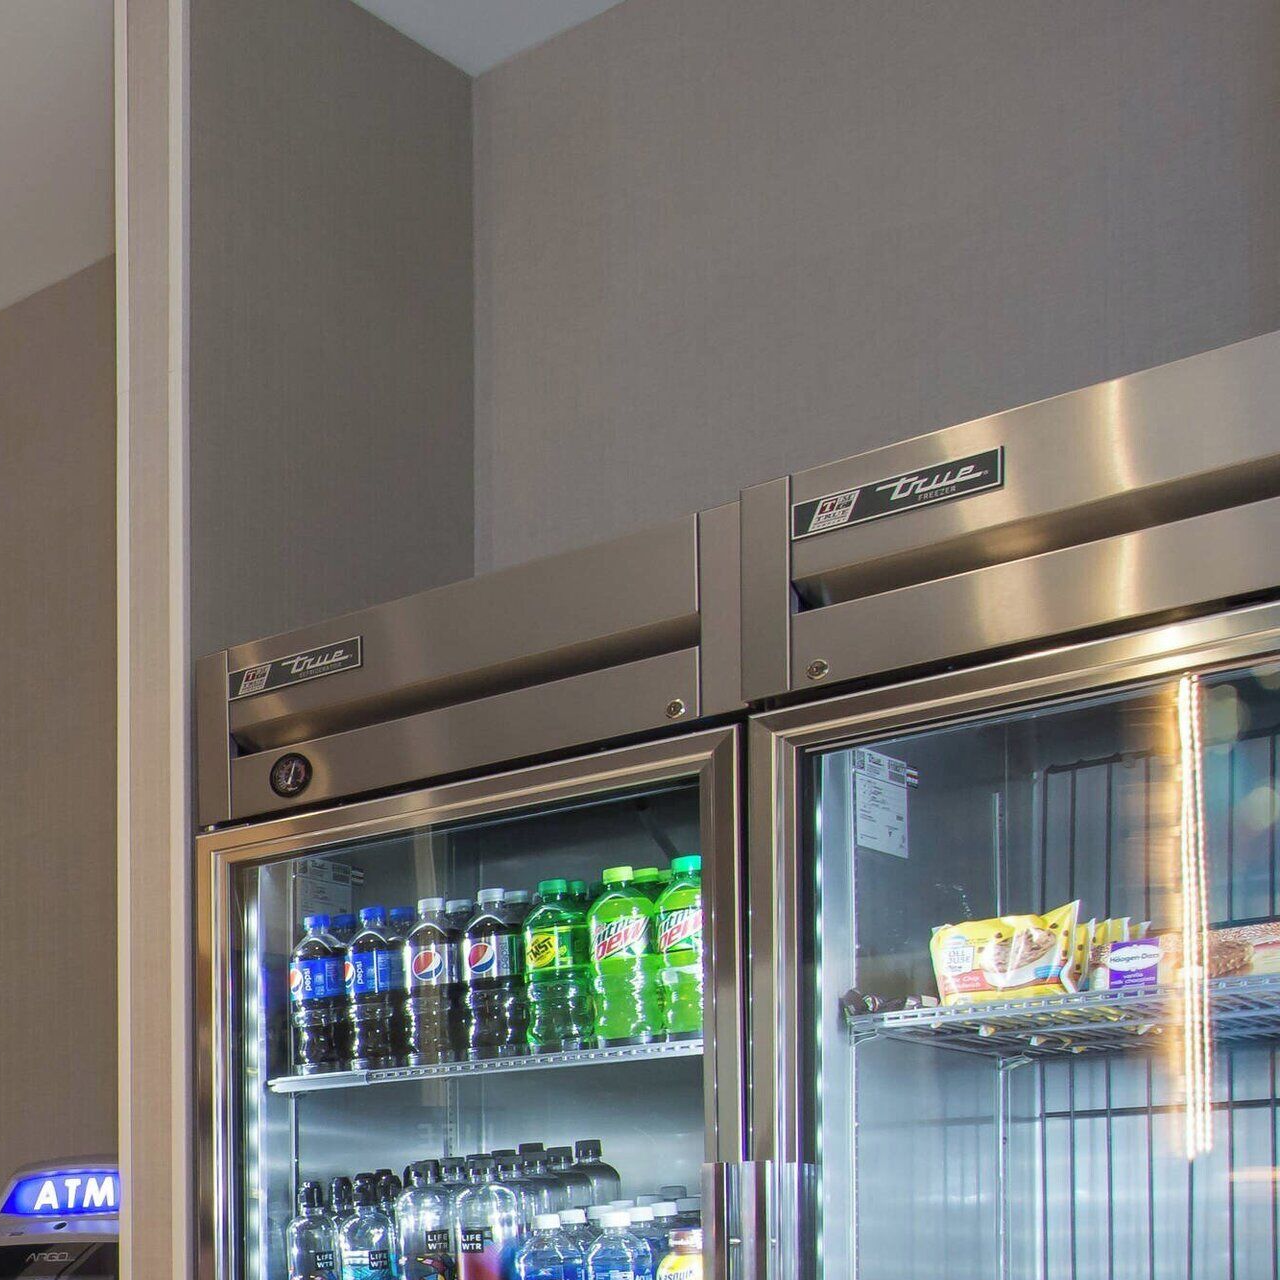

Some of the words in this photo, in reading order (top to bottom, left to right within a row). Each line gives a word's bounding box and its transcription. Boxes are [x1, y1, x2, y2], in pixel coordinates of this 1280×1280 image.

[918, 486, 956, 501] FREEZER
[34, 1177, 116, 1210] ATM
[428, 1233, 449, 1242] LIFE
[462, 1233, 482, 1242] LIFE
[428, 1241, 449, 1250] WTR
[462, 1242, 482, 1250] WTR
[370, 1260, 388, 1268] WTR
